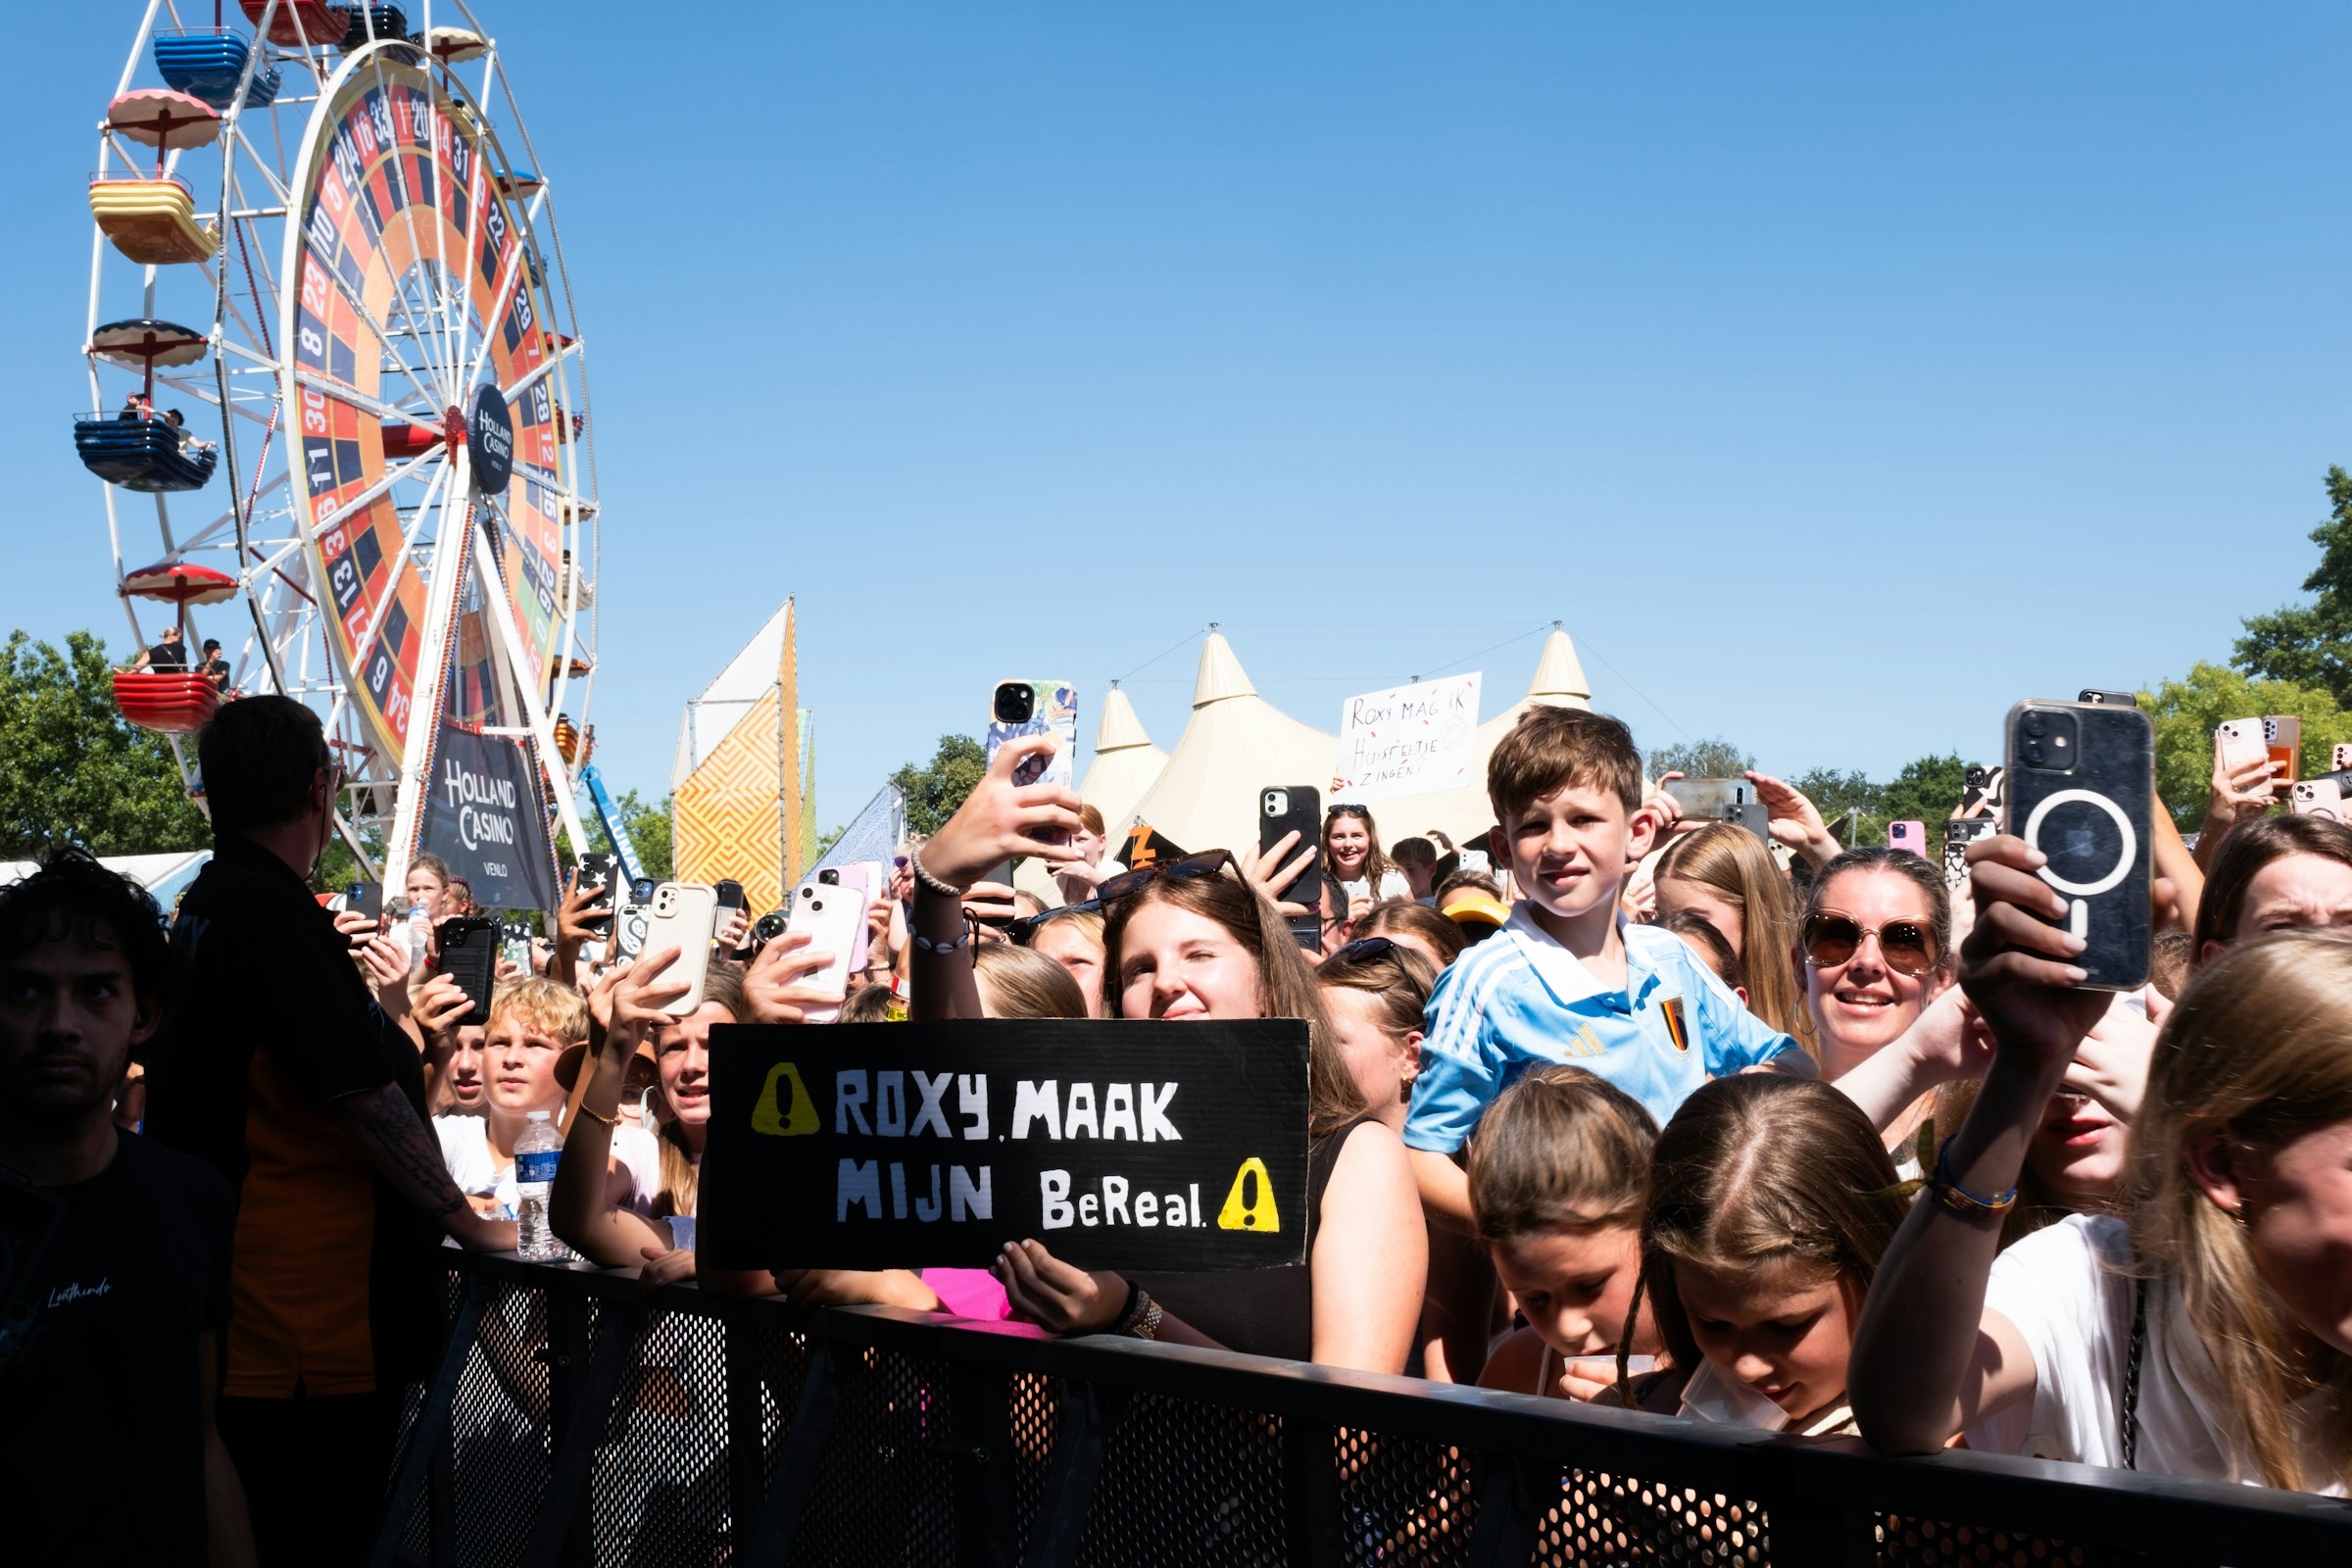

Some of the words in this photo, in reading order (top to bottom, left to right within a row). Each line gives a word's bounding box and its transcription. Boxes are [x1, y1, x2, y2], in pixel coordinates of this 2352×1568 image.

[354, 110, 375, 158] 16
[397, 95, 409, 135] 1
[411, 98, 431, 141] 20
[453, 134, 469, 181] 31
[323, 171, 343, 212] 5
[488, 201, 506, 250] 22
[303, 261, 328, 319] 23
[515, 287, 532, 331] 29
[300, 326, 323, 358] 8
[527, 337, 541, 357] 7
[303, 369, 326, 434] 30
[534, 383, 550, 422] 28
[307, 447, 333, 488] 11
[540, 430, 555, 464] 12
[316, 495, 346, 558] 36
[543, 531, 557, 555] 3
[333, 559, 358, 609] 13
[372, 656, 388, 694] 6
[387, 681, 411, 734] 34
[444, 758, 516, 809] HOLLAND
[459, 805, 514, 852] CASINO
[483, 861, 509, 878] VENLO
[1011, 1079, 1183, 1143] MAAK
[836, 1157, 994, 1223] MIJN
[1040, 1168, 1207, 1231] BeReal.
